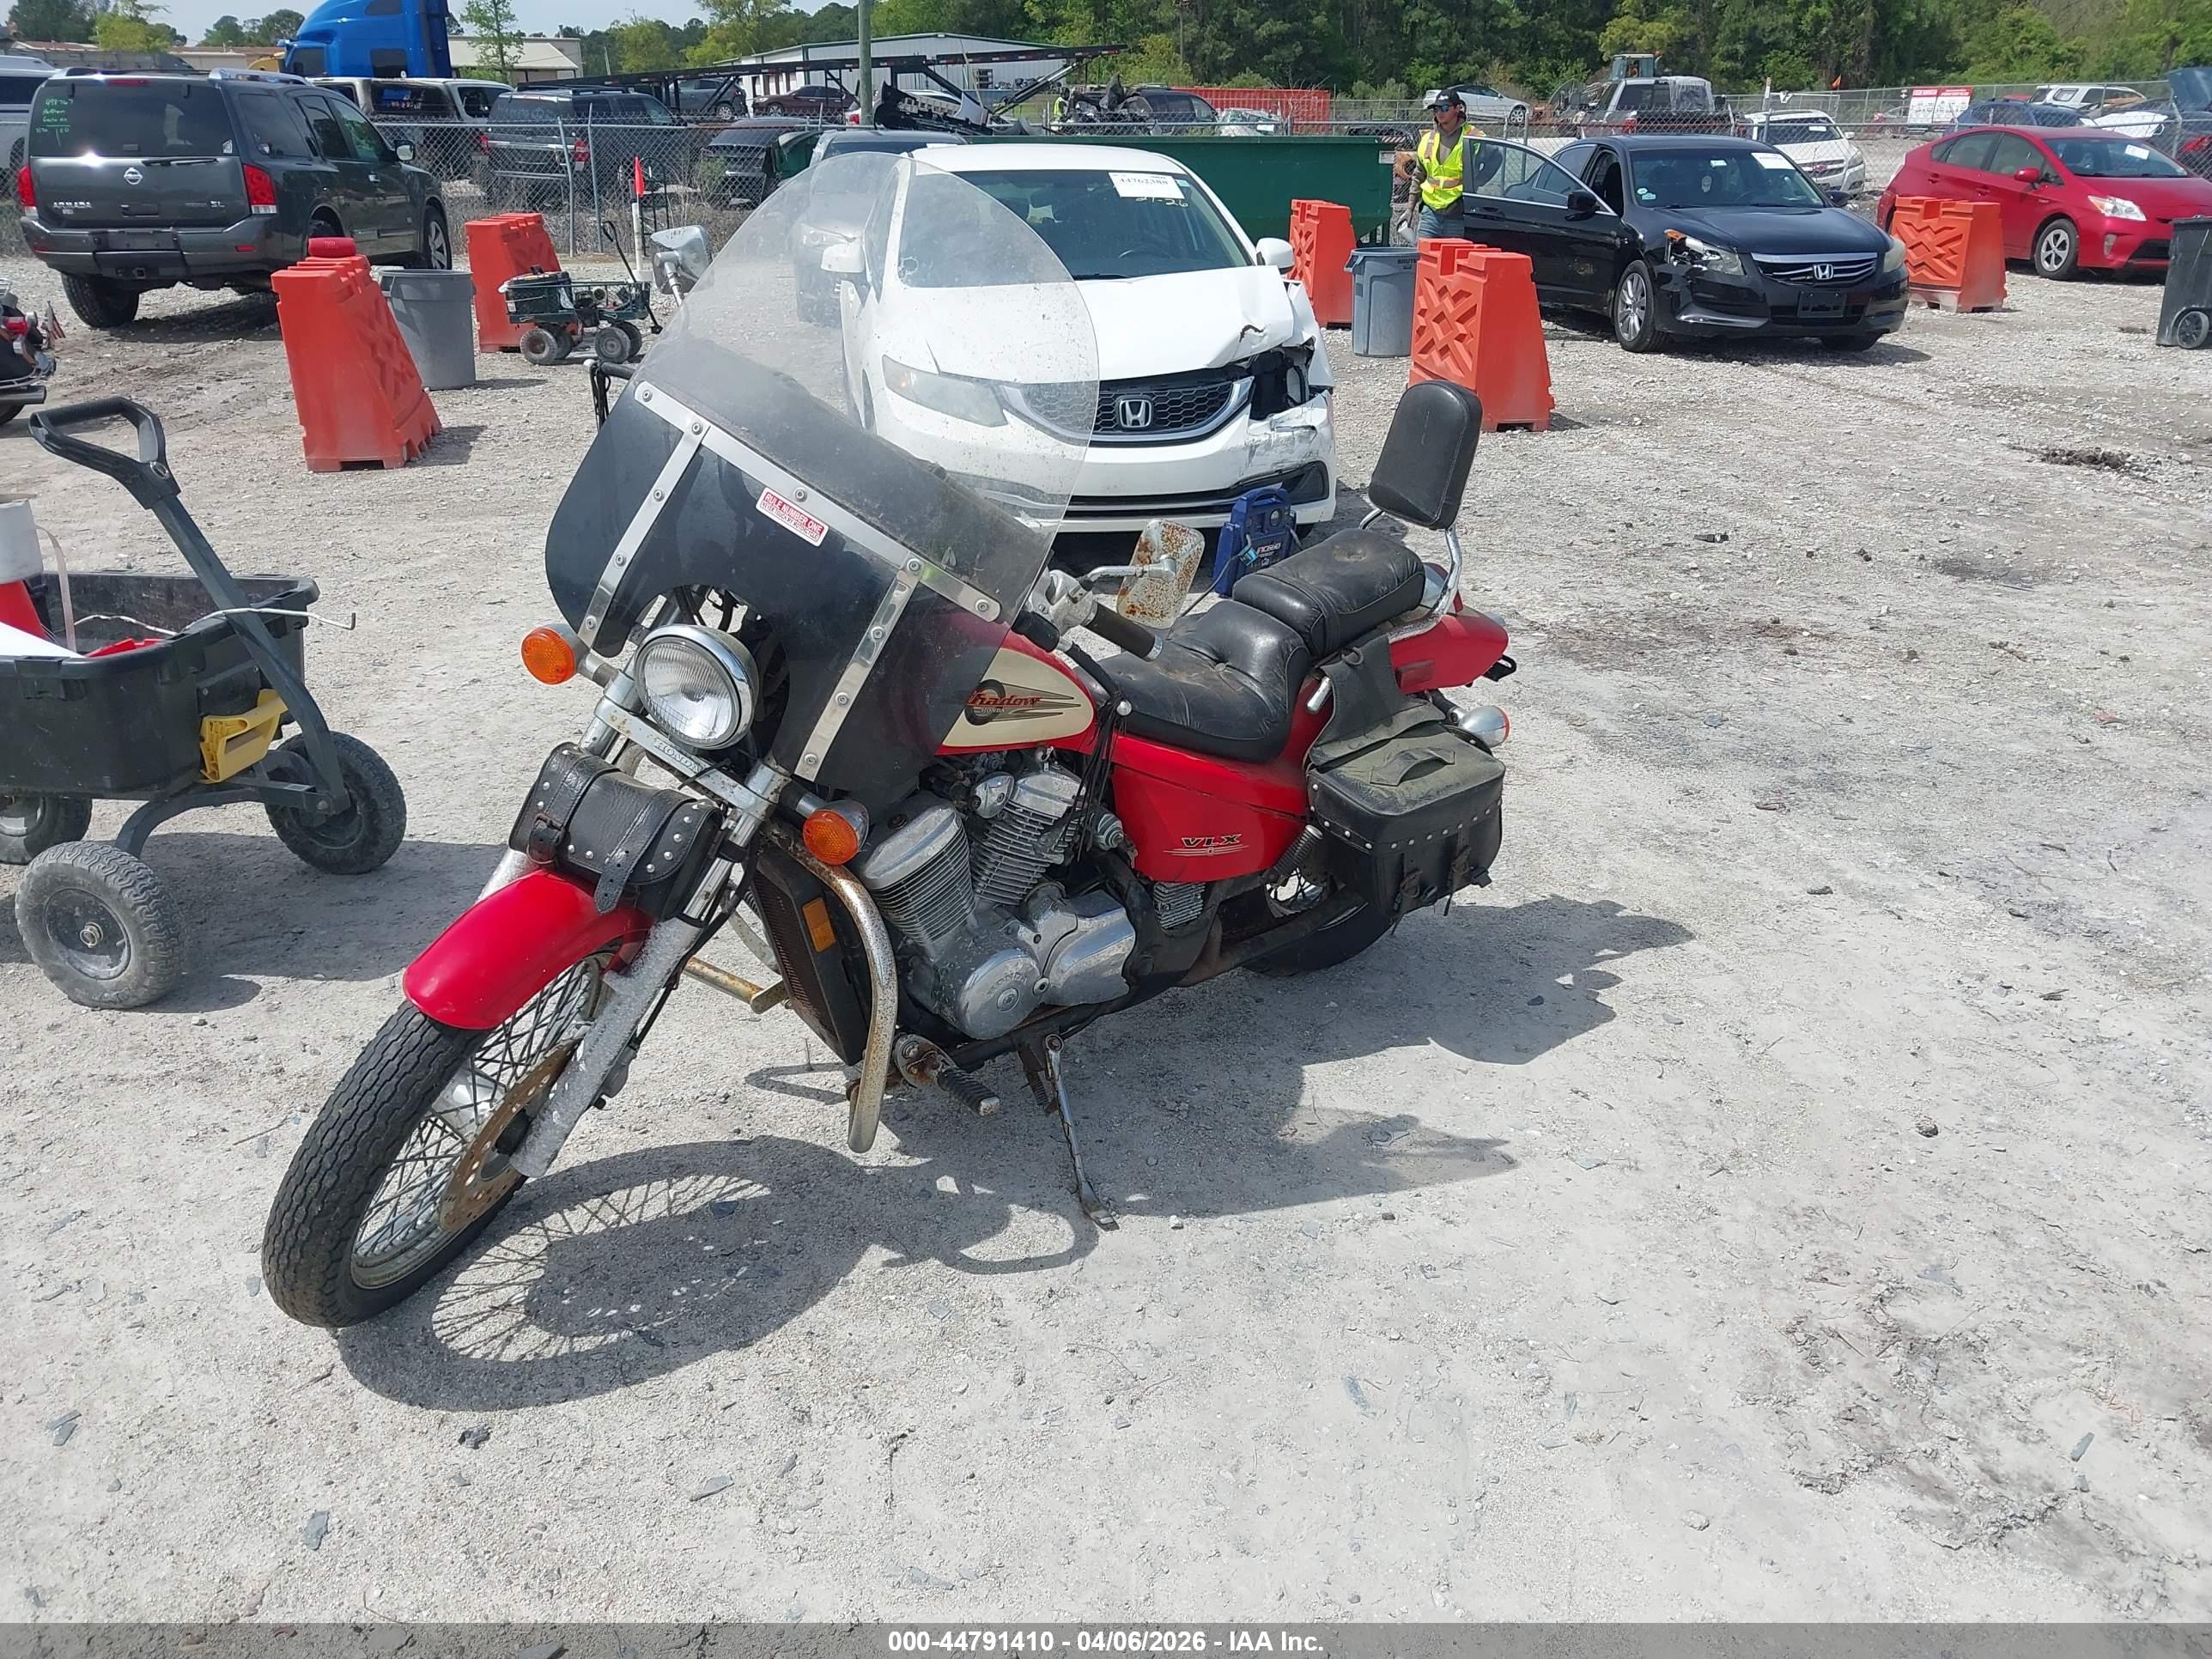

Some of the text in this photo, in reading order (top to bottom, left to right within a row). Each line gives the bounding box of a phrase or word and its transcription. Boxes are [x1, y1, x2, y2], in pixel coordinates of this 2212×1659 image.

[764, 493, 823, 534] RULE NUMBER ONE
[653, 738, 704, 774] HONDA
[1182, 833, 1242, 848] VLX
